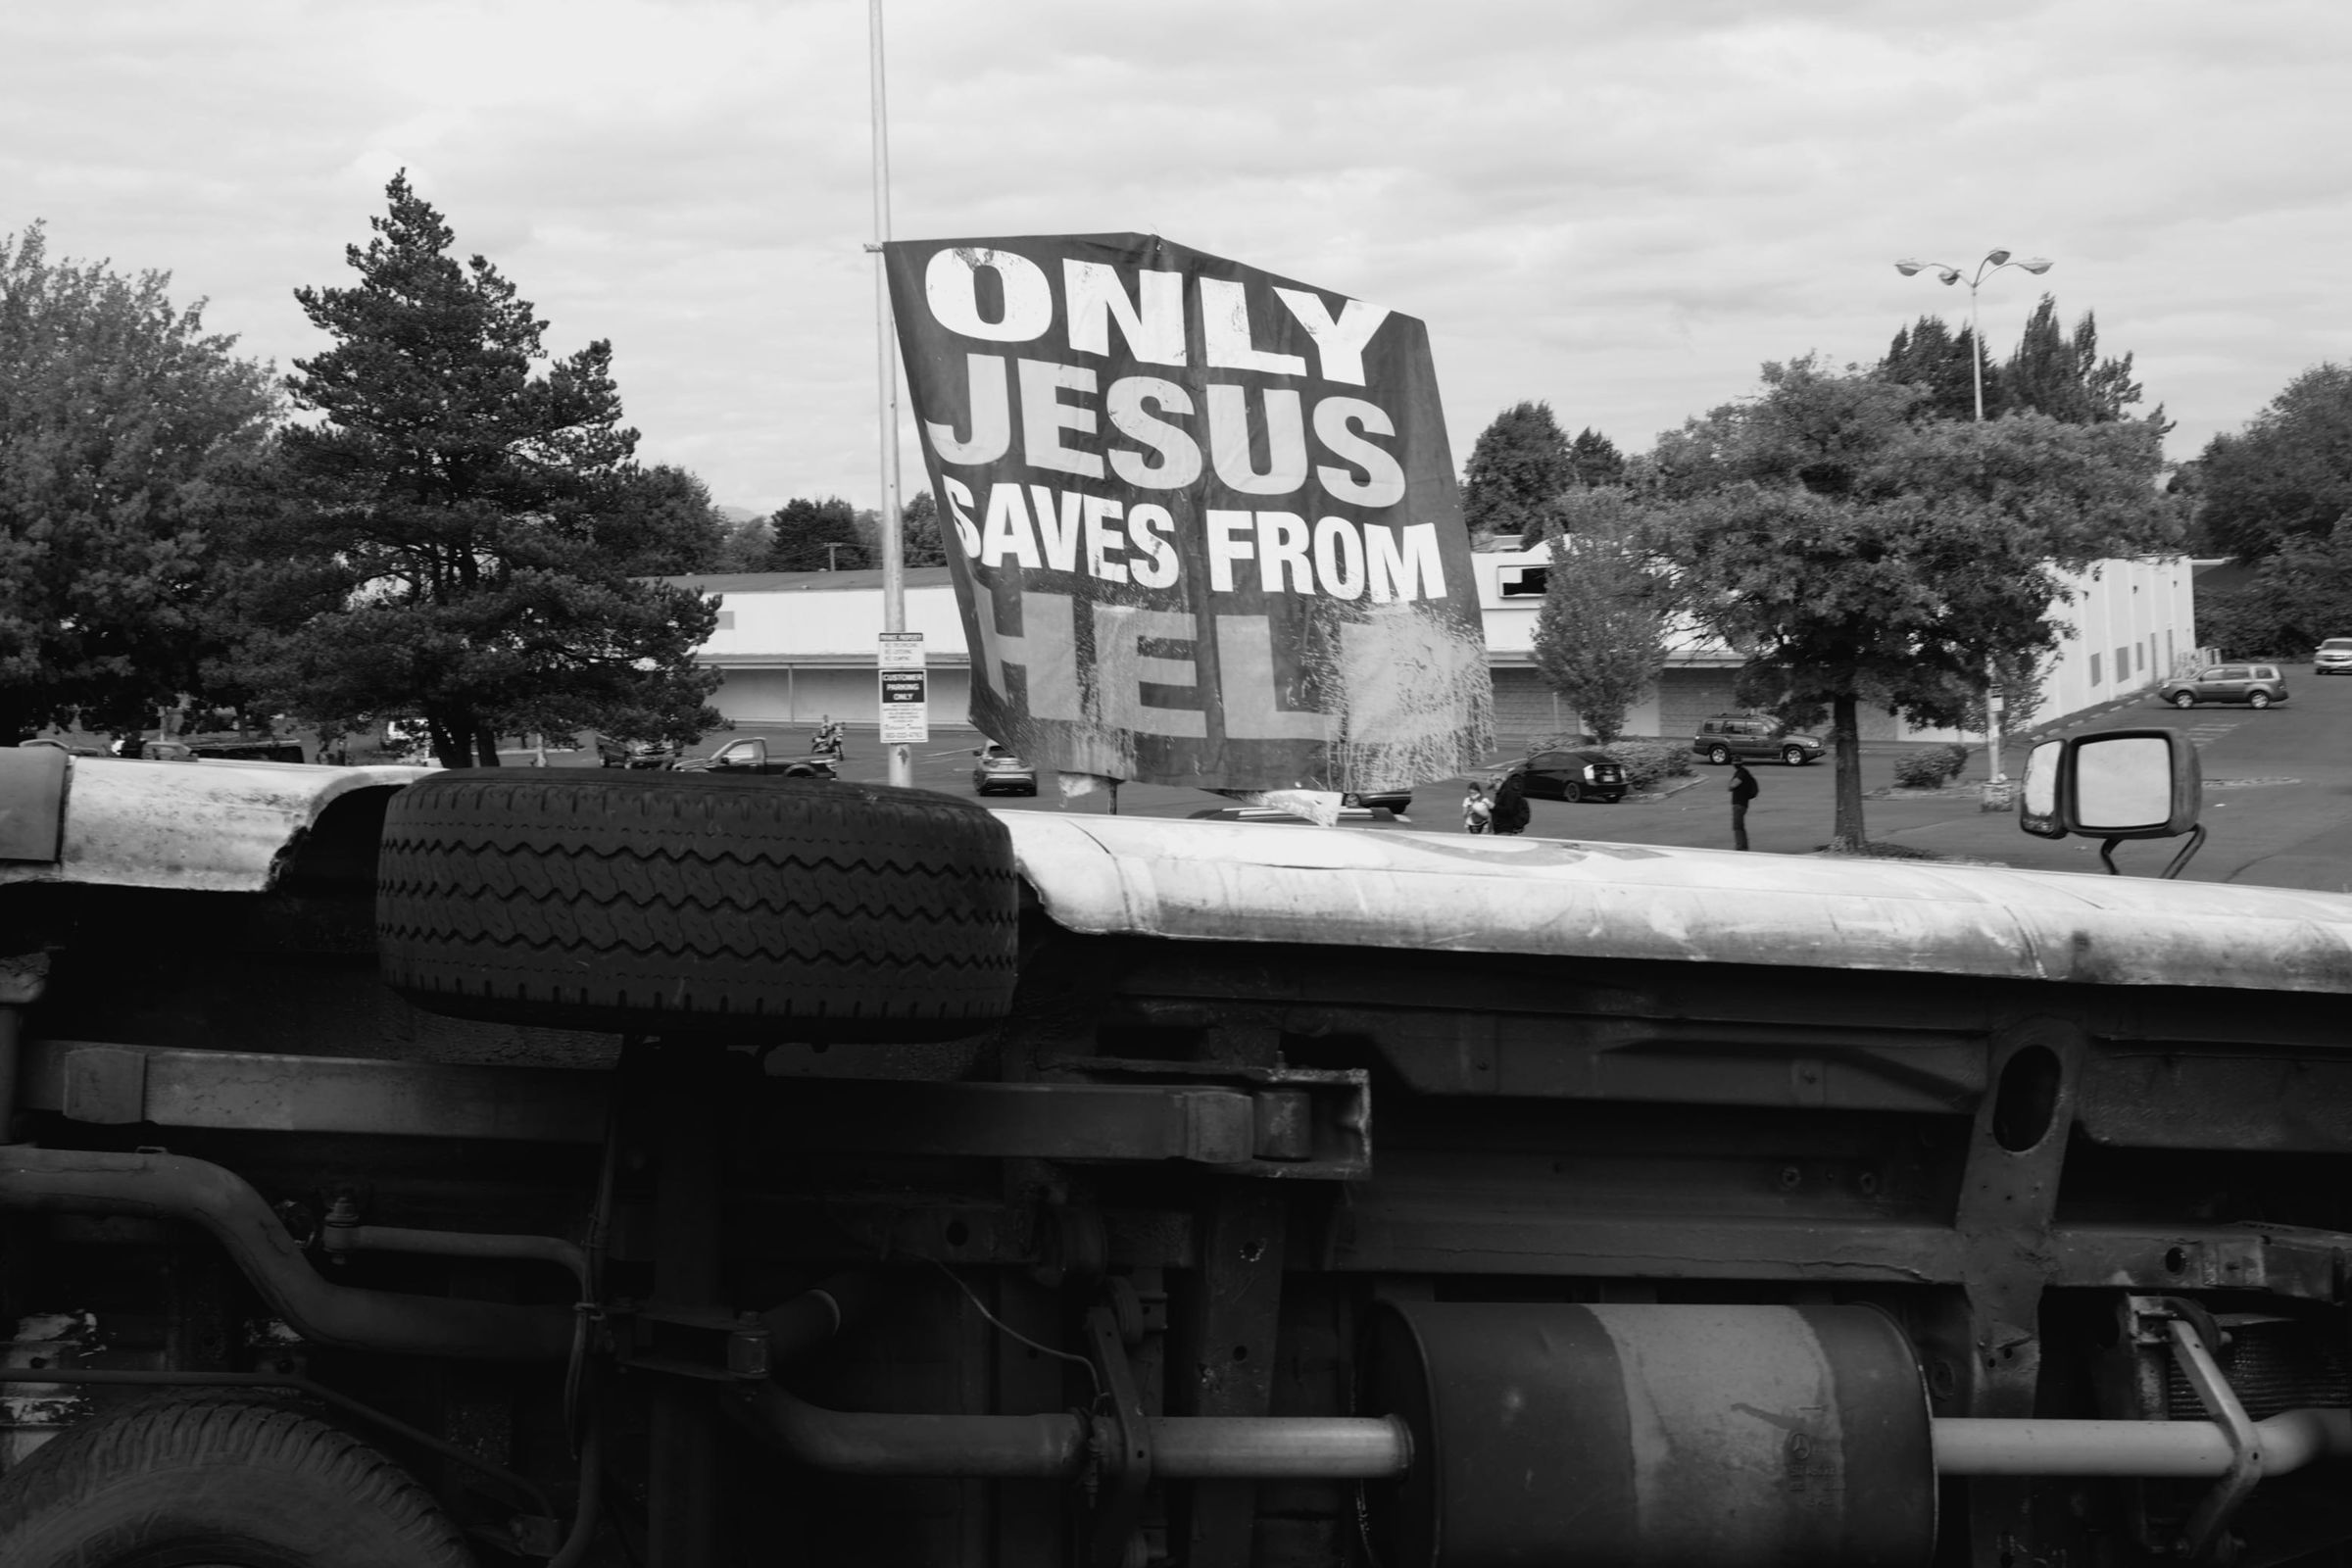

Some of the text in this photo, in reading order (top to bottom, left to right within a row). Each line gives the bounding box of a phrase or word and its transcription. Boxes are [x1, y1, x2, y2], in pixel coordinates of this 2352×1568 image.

[925, 247, 1392, 386] ONLY
[925, 353, 1405, 508] JESUS
[943, 475, 1447, 603] SAVES FROM
